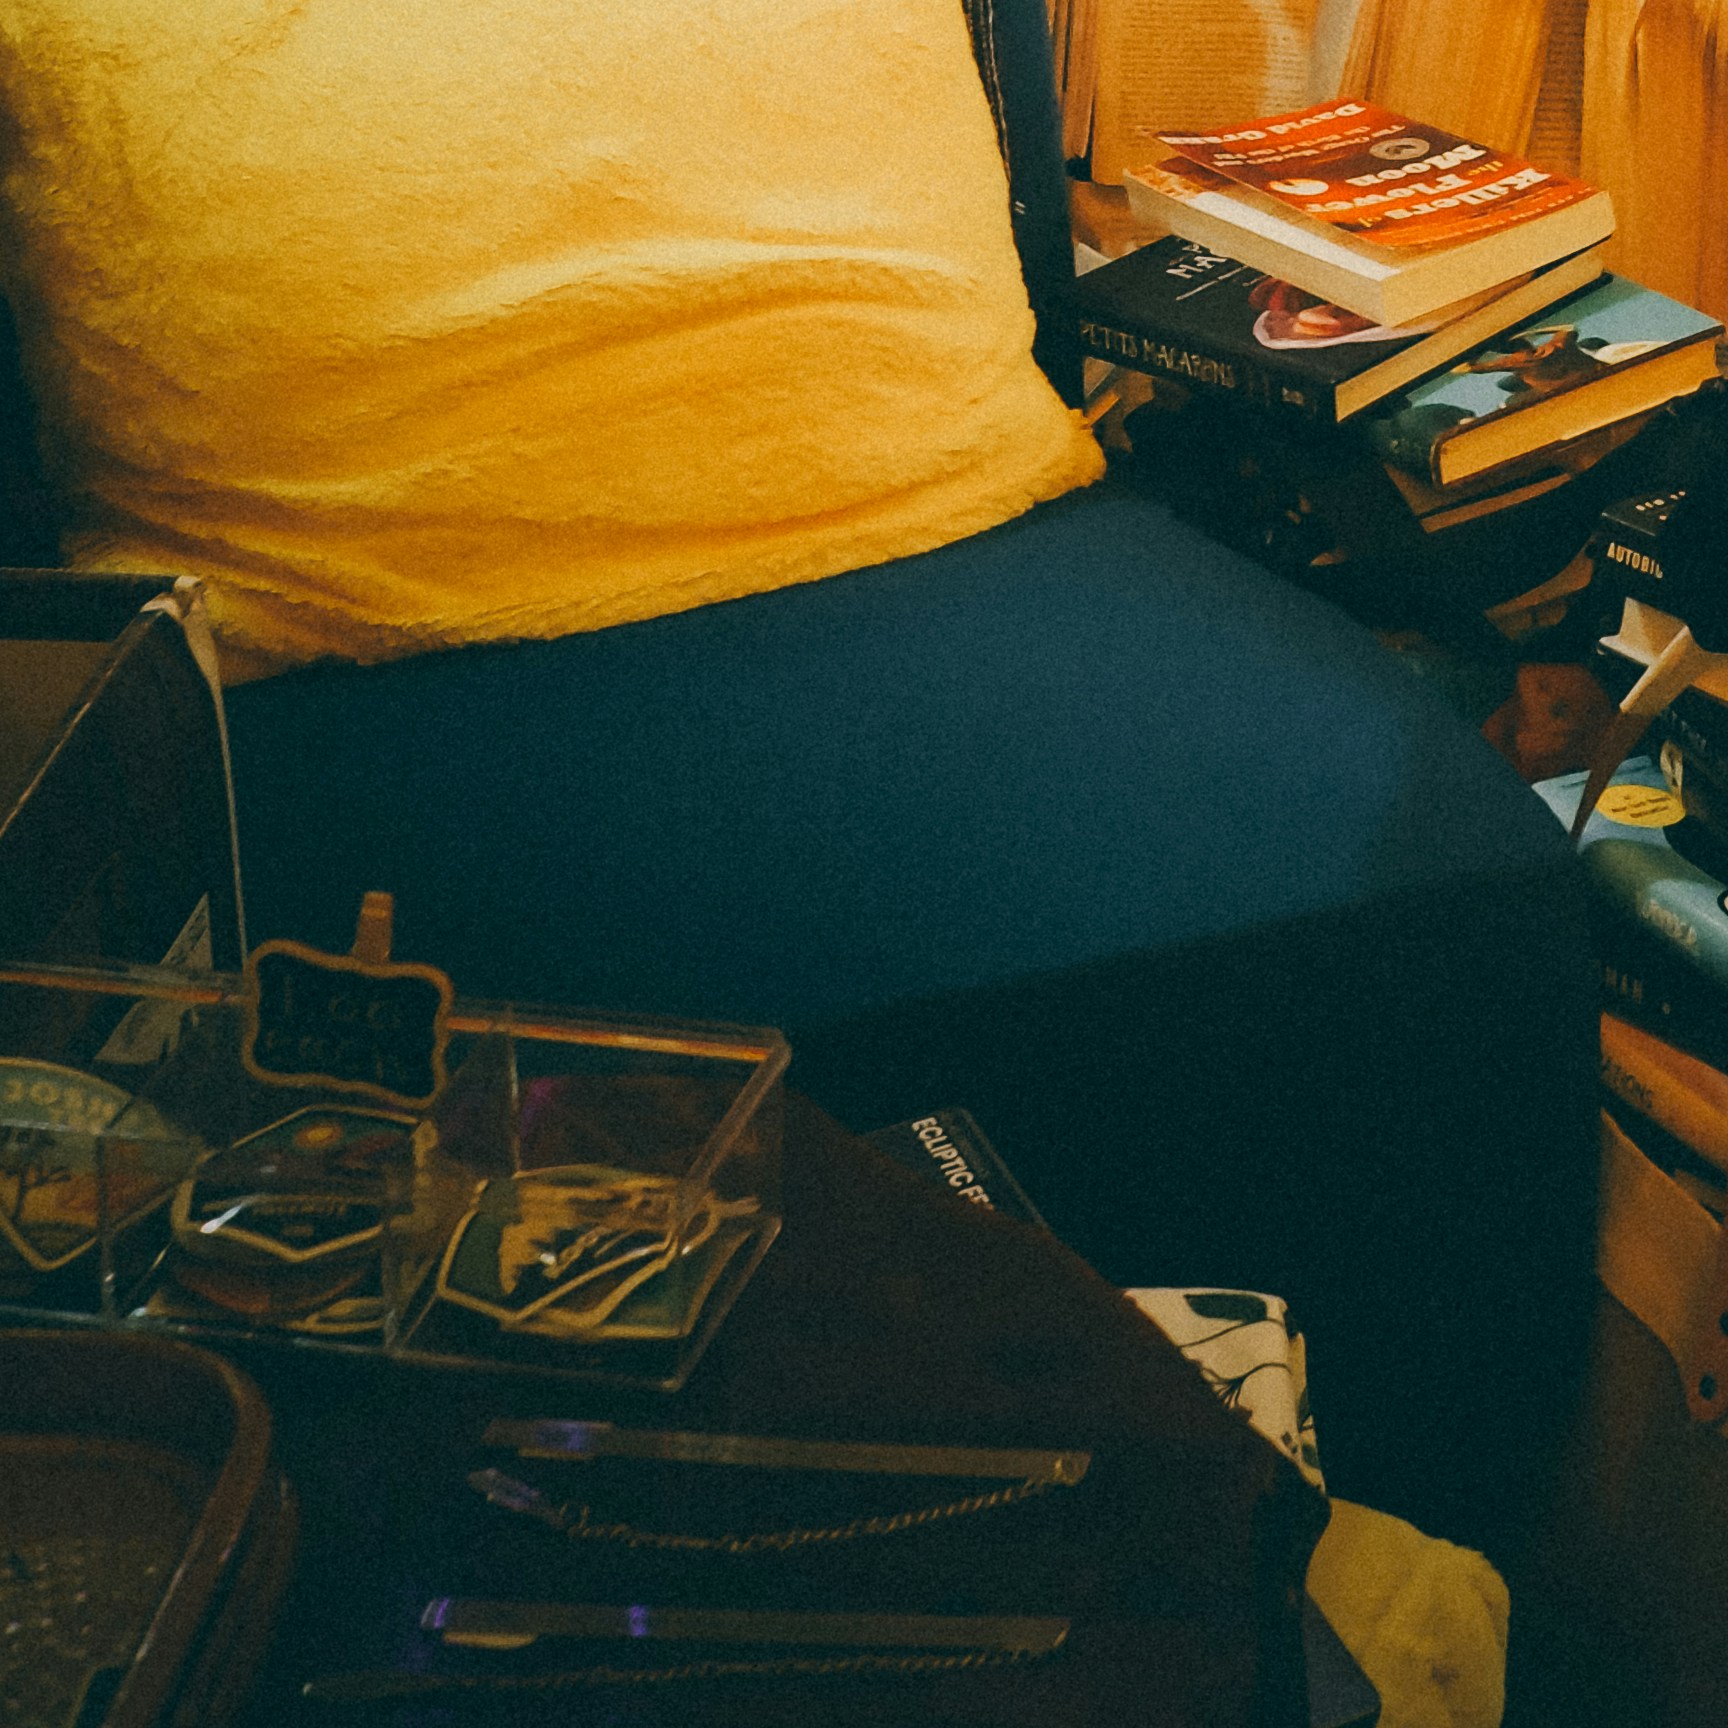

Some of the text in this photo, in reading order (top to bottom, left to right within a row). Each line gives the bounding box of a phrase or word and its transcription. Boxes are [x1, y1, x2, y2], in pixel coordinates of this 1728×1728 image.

[1265, 103, 1367, 135] David
[1305, 160, 1503, 213] the Flower
[1345, 143, 1488, 186] Moon
[1384, 167, 1552, 219] Killers
[911, 1116, 975, 1188] ECLIPTIC
